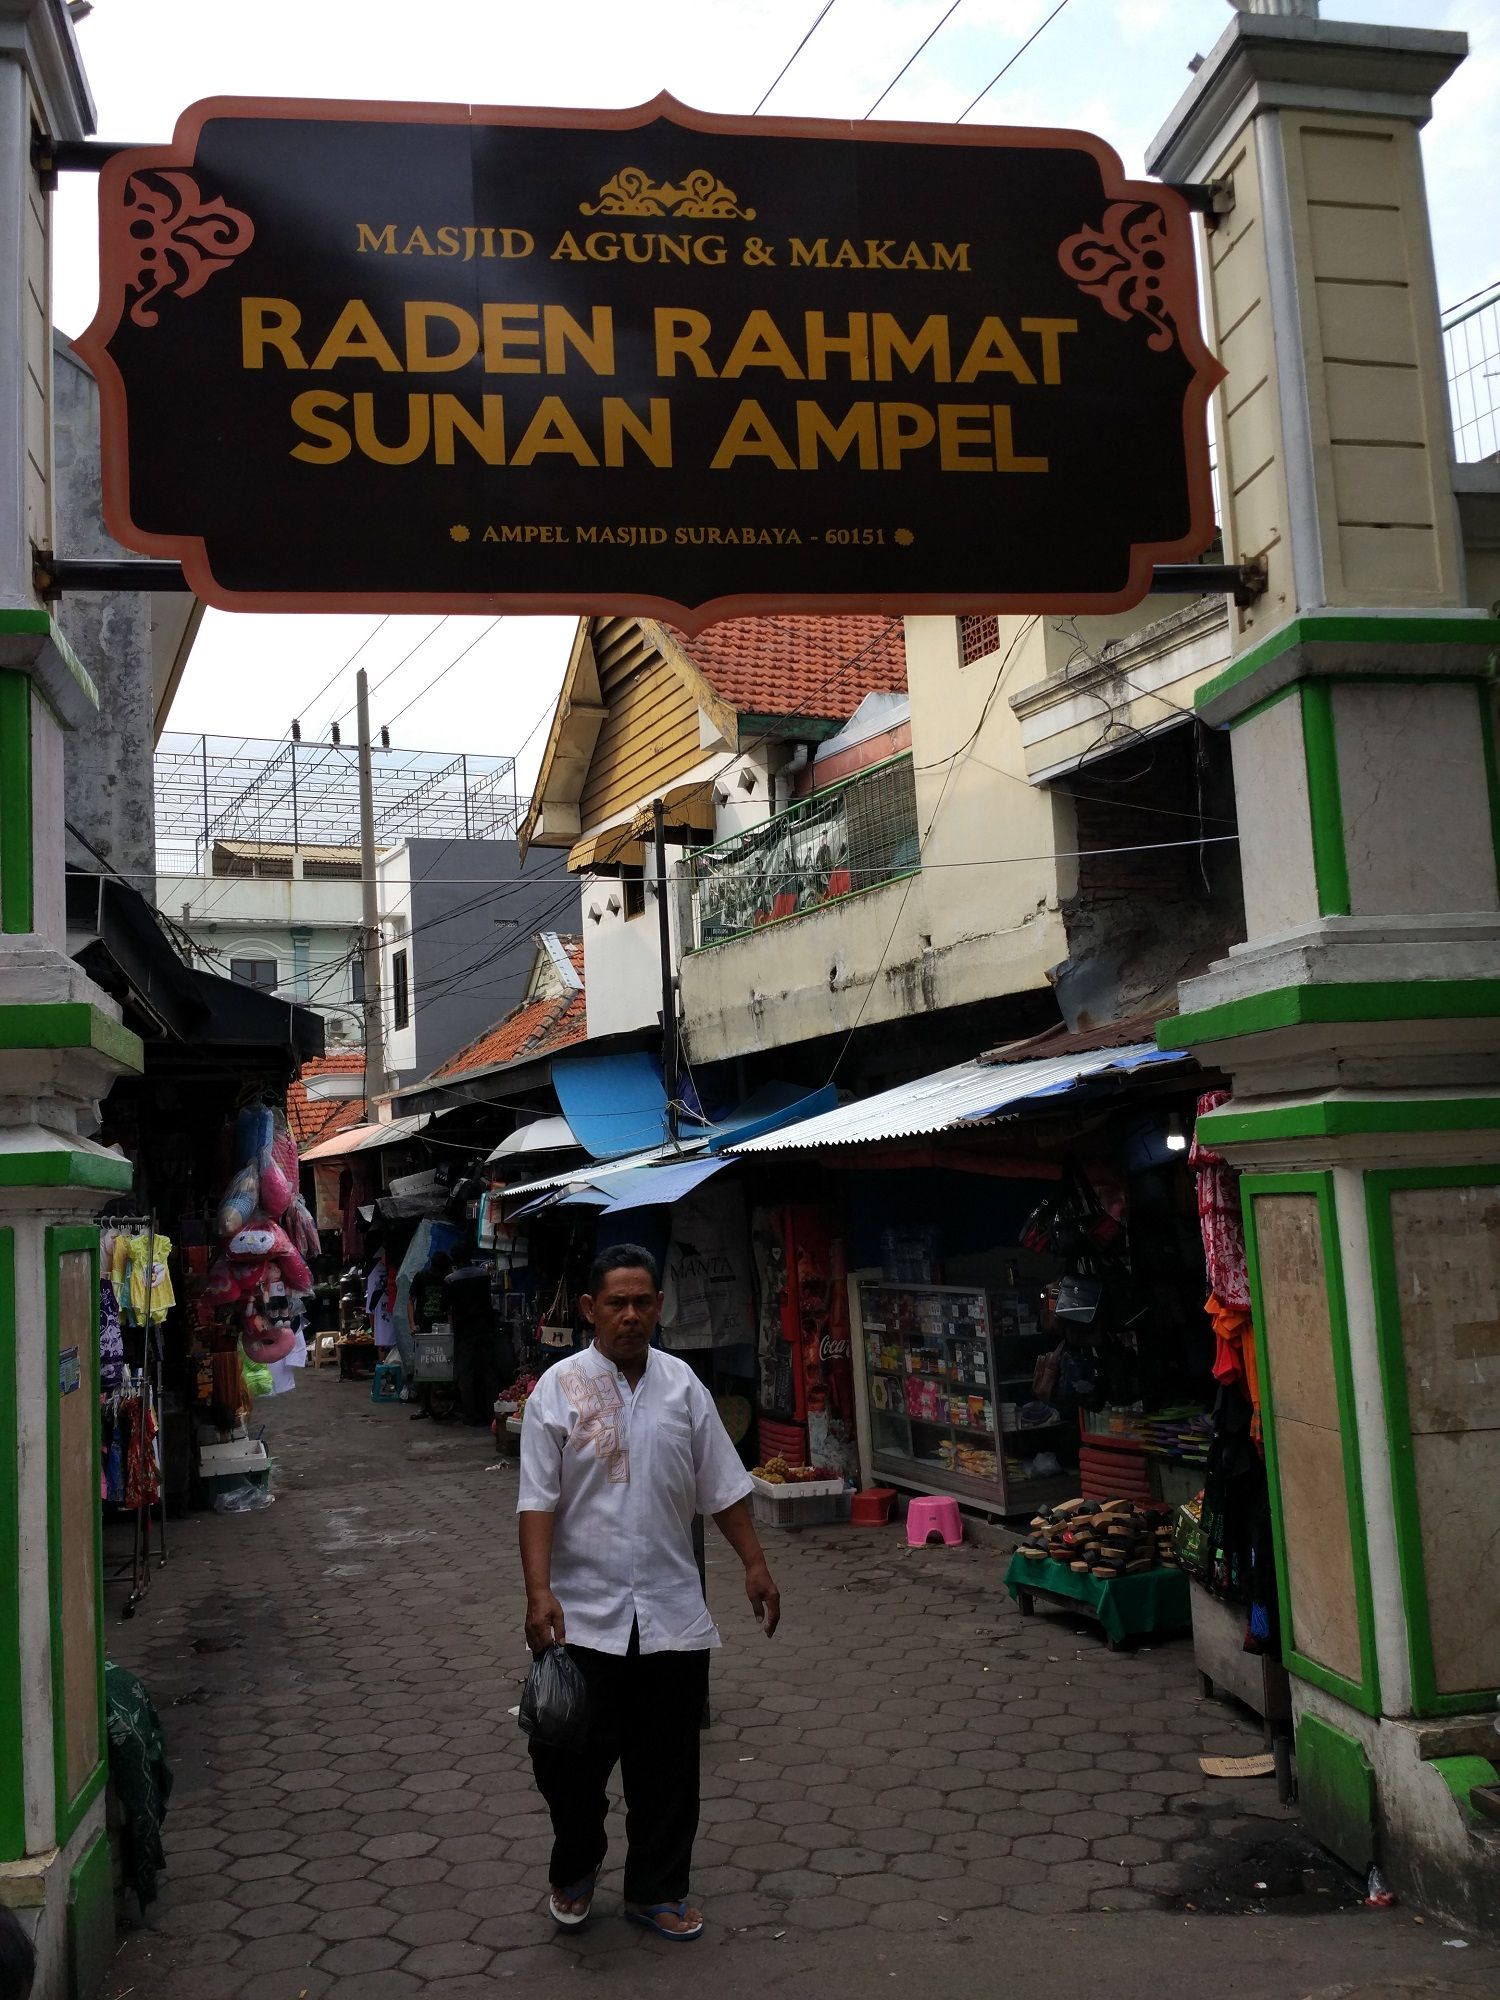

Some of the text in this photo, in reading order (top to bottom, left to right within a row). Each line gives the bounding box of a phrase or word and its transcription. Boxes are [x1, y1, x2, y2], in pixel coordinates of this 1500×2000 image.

[357, 223, 972, 272] MASJID AGUNG & MAKAM
[241, 296, 1079, 385] RADEN RAHMAT
[289, 390, 1049, 473] SUNAN AMPEL
[482, 525, 569, 544] AMPEL
[576, 526, 667, 547] MASJID
[675, 527, 802, 545] SURABAYA
[825, 528, 885, 545] 60151
[670, 1256, 733, 1281] MANTA
